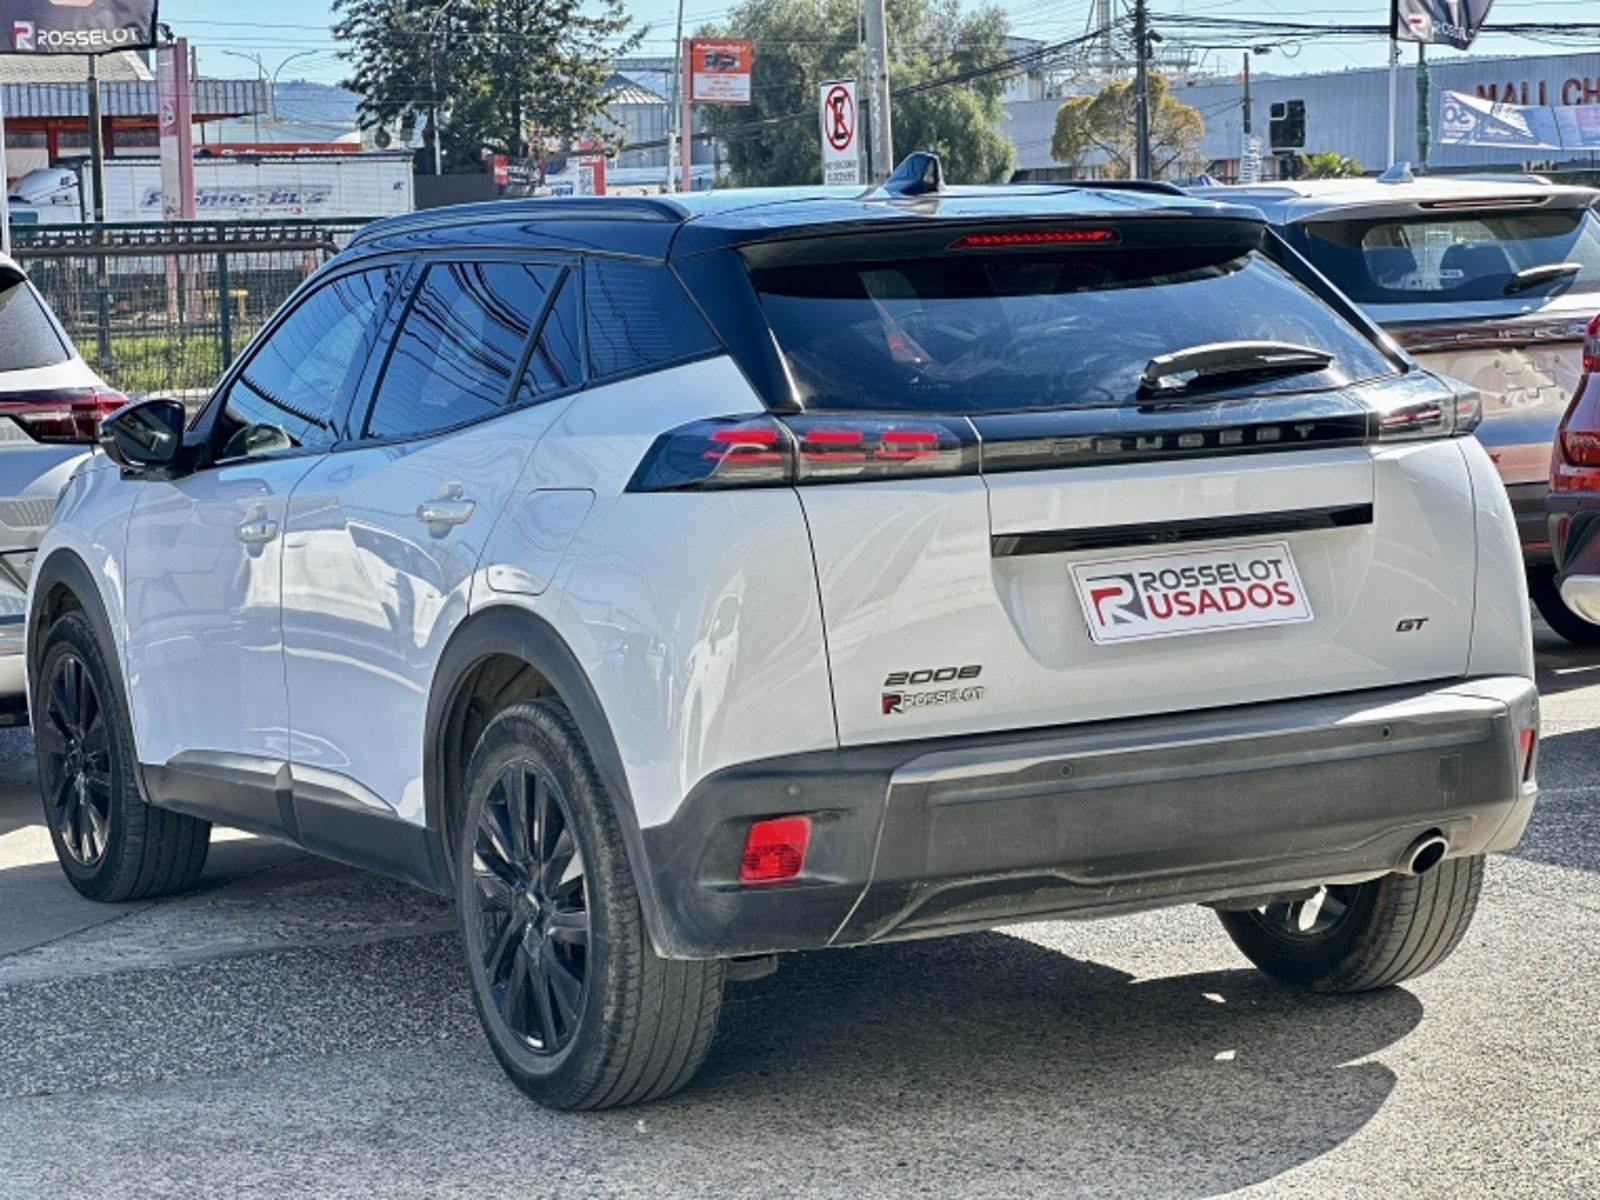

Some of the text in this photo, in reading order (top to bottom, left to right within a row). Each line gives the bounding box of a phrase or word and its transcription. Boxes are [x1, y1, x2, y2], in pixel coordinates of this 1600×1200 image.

[37, 27, 139, 46] ROSSELOT
[1052, 423, 1316, 456] PEUGEOT
[1139, 559, 1284, 592] ROSSELOT
[1147, 580, 1296, 619] USADOS
[1396, 617, 1429, 632] GT
[884, 664, 983, 687] 2008
[903, 686, 985, 710] ROSSELOT
